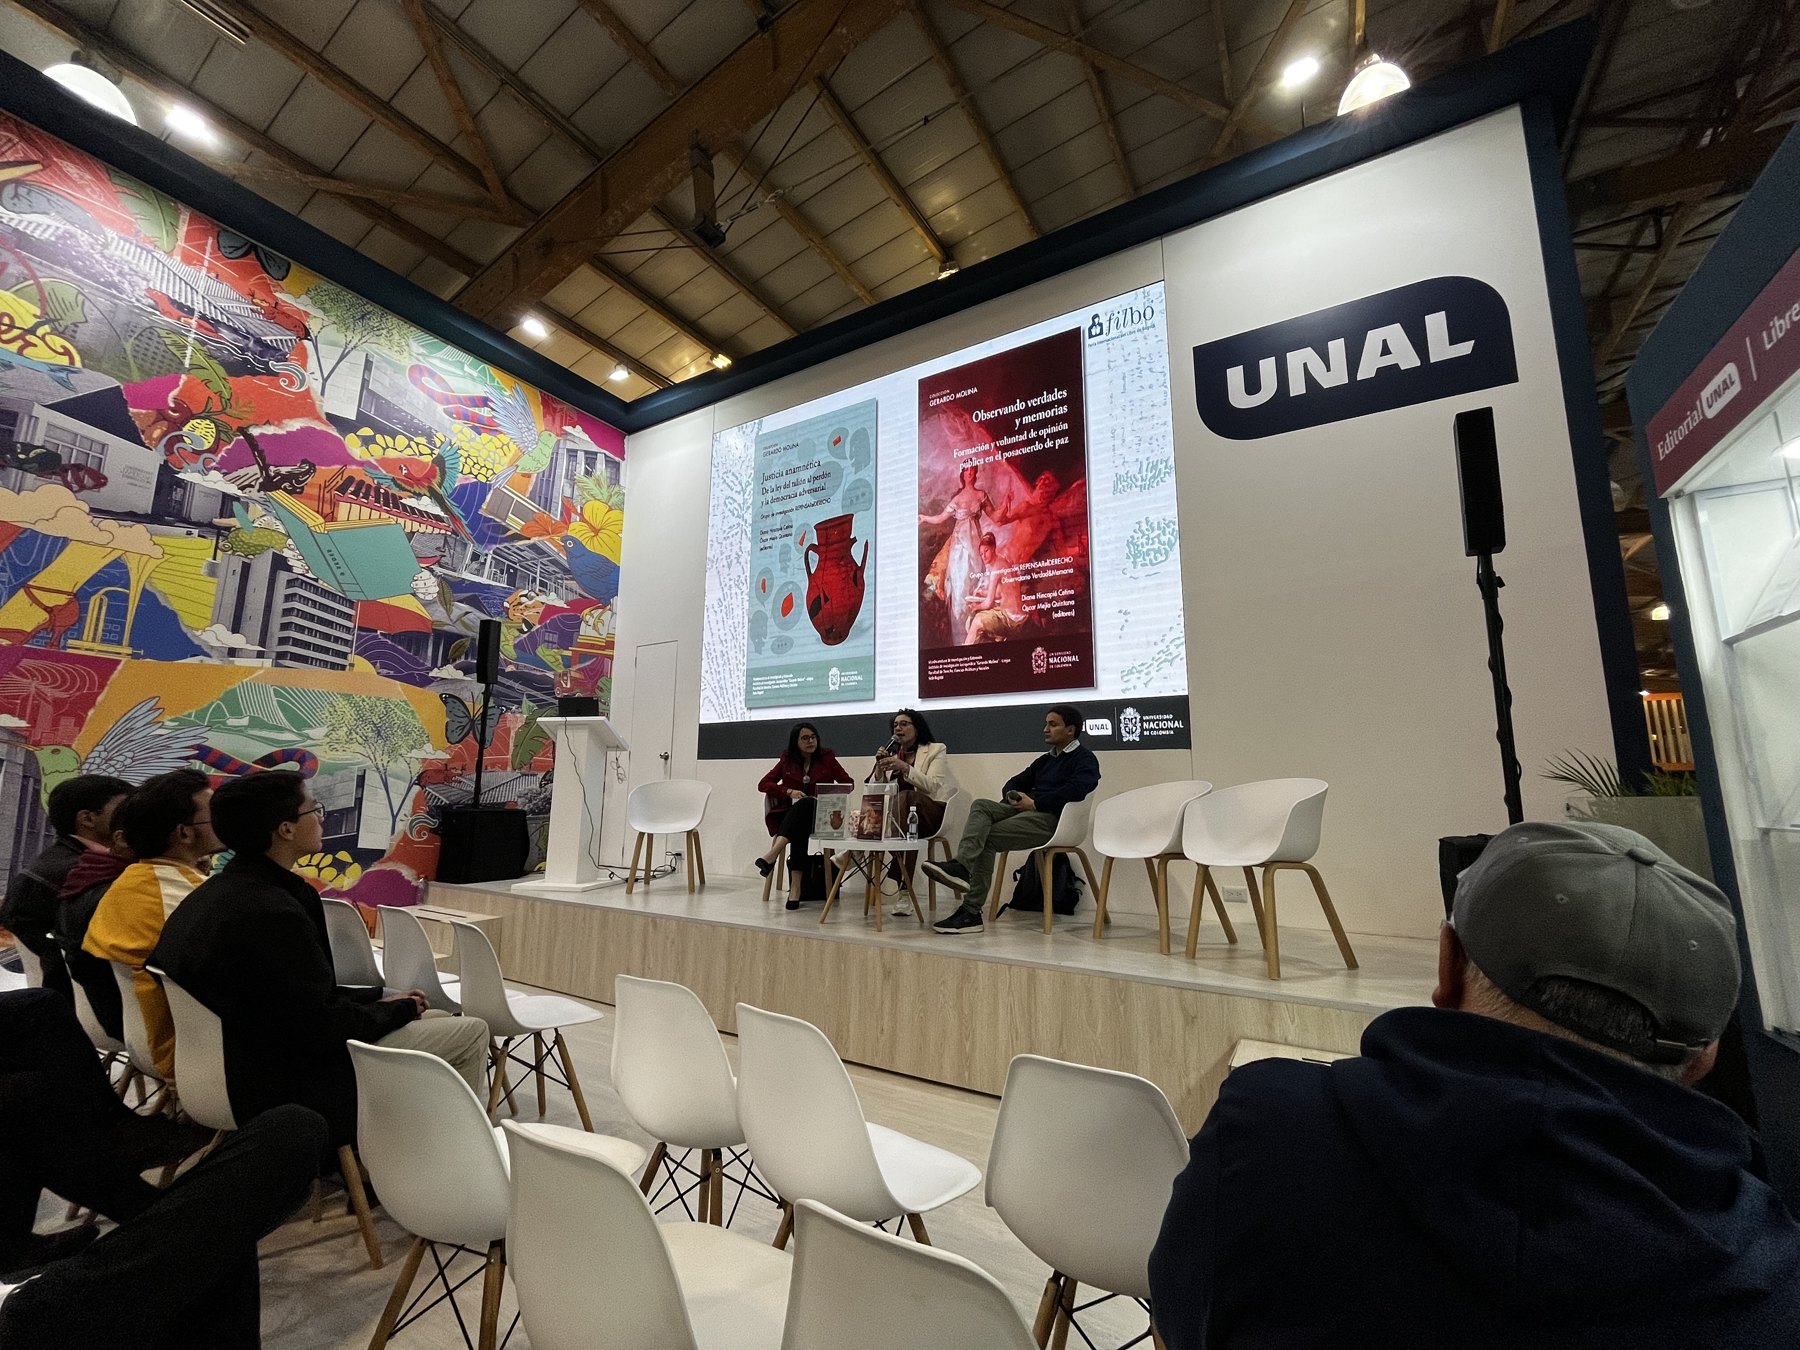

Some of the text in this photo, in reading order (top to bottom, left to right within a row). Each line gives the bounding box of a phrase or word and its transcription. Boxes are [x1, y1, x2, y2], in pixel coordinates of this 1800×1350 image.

[1226, 310, 1475, 408] UNAL
[929, 387, 978, 407] GERARDO MOLINA
[972, 388, 1068, 423] Observando verdades
[1014, 404, 1068, 430] y memorias
[1657, 373, 1735, 461] Editorial UNAL
[954, 421, 1069, 458] Formación y voluntad de opinión
[960, 436, 1069, 472] pública en el posacuerdo de paz
[761, 459, 821, 485] Justicia anamnética
[762, 486, 769, 496] De
[812, 470, 832, 485] perdón
[760, 500, 764, 509] y
[770, 492, 798, 504] democracia
[1022, 593, 1035, 602] Diana
[1052, 600, 1075, 608] Quintana
[1052, 609, 1075, 619] (editores)
[1049, 655, 1079, 663] NACIONAL
[1143, 720, 1184, 729] NACIONAL
